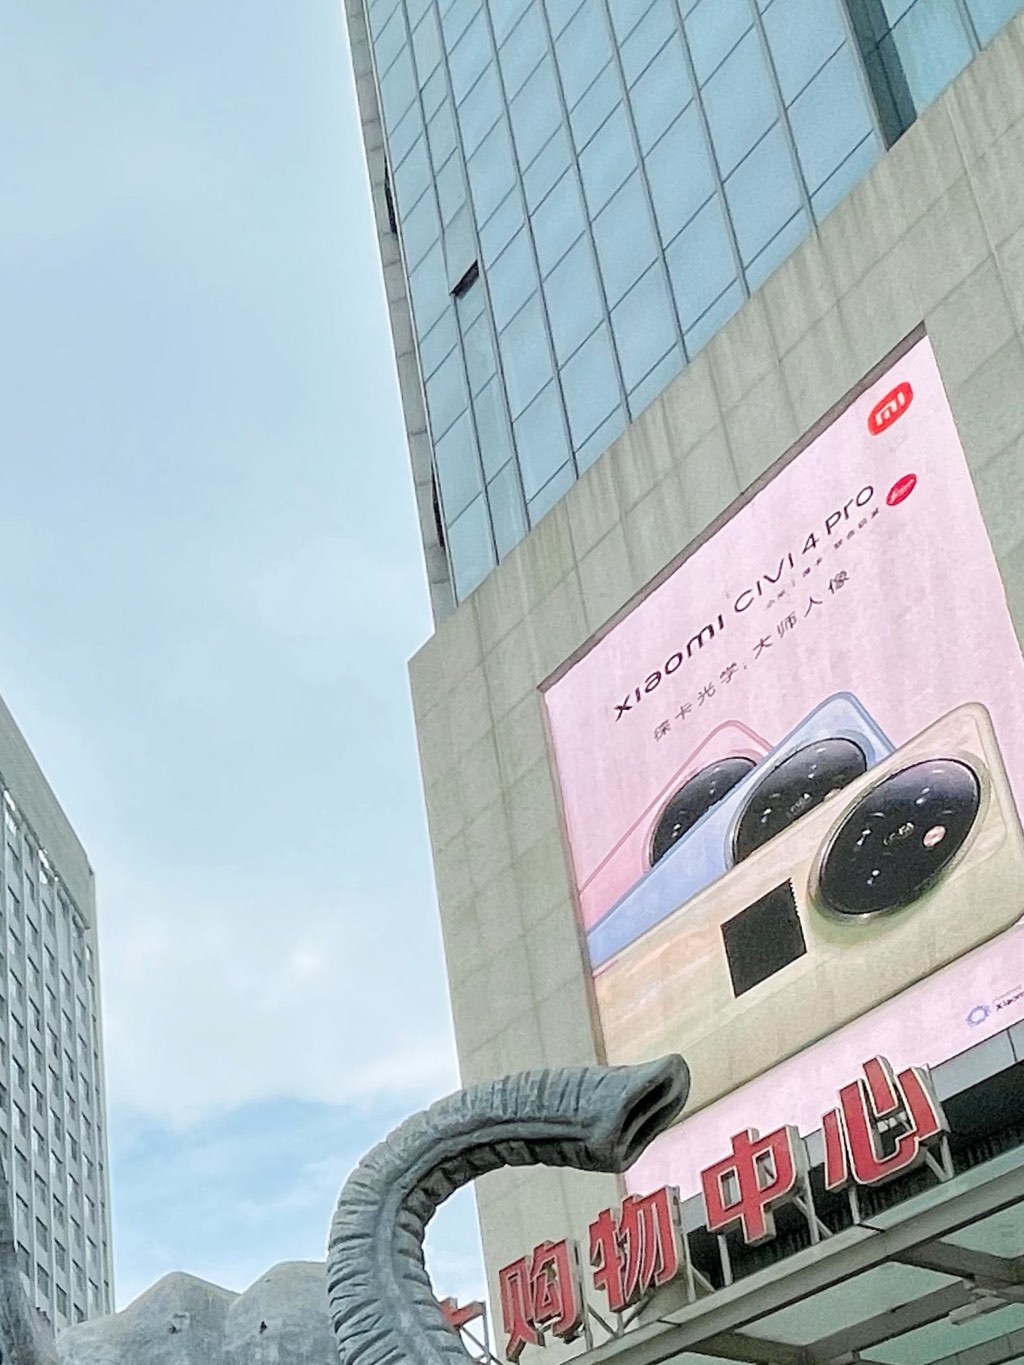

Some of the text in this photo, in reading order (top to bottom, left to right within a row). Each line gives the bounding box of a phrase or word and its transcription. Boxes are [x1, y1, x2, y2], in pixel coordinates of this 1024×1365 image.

[733, 552, 795, 613] CIVI
[801, 532, 820, 555] 4
[824, 485, 874, 535] Pro
[498, 1055, 946, 1362] 购物中心
